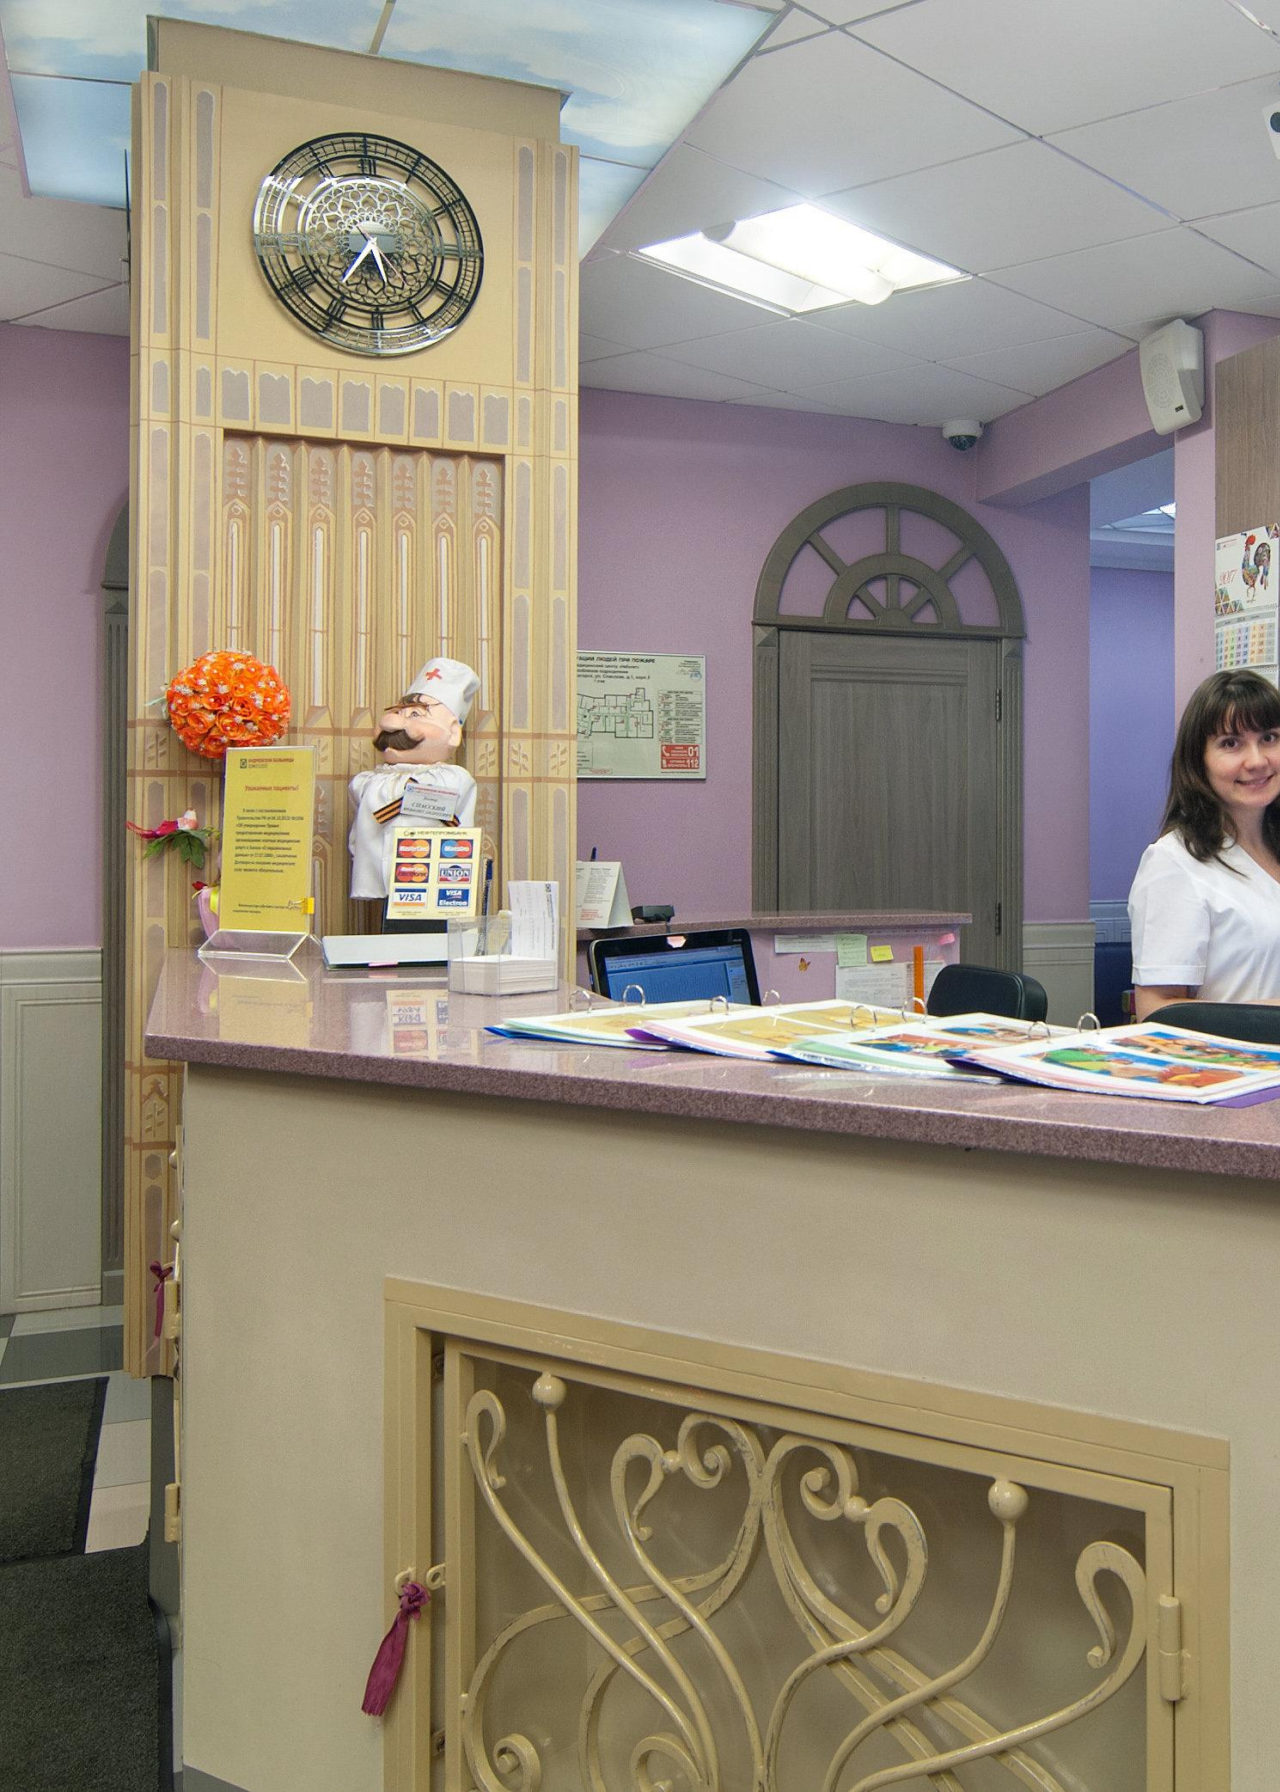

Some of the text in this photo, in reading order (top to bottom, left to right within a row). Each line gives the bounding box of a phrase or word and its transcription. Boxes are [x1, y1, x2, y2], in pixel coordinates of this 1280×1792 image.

[688, 746, 699, 757] 01
[687, 760, 699, 768] 112
[441, 869, 470, 877] UNION
[399, 893, 422, 902] VISA
